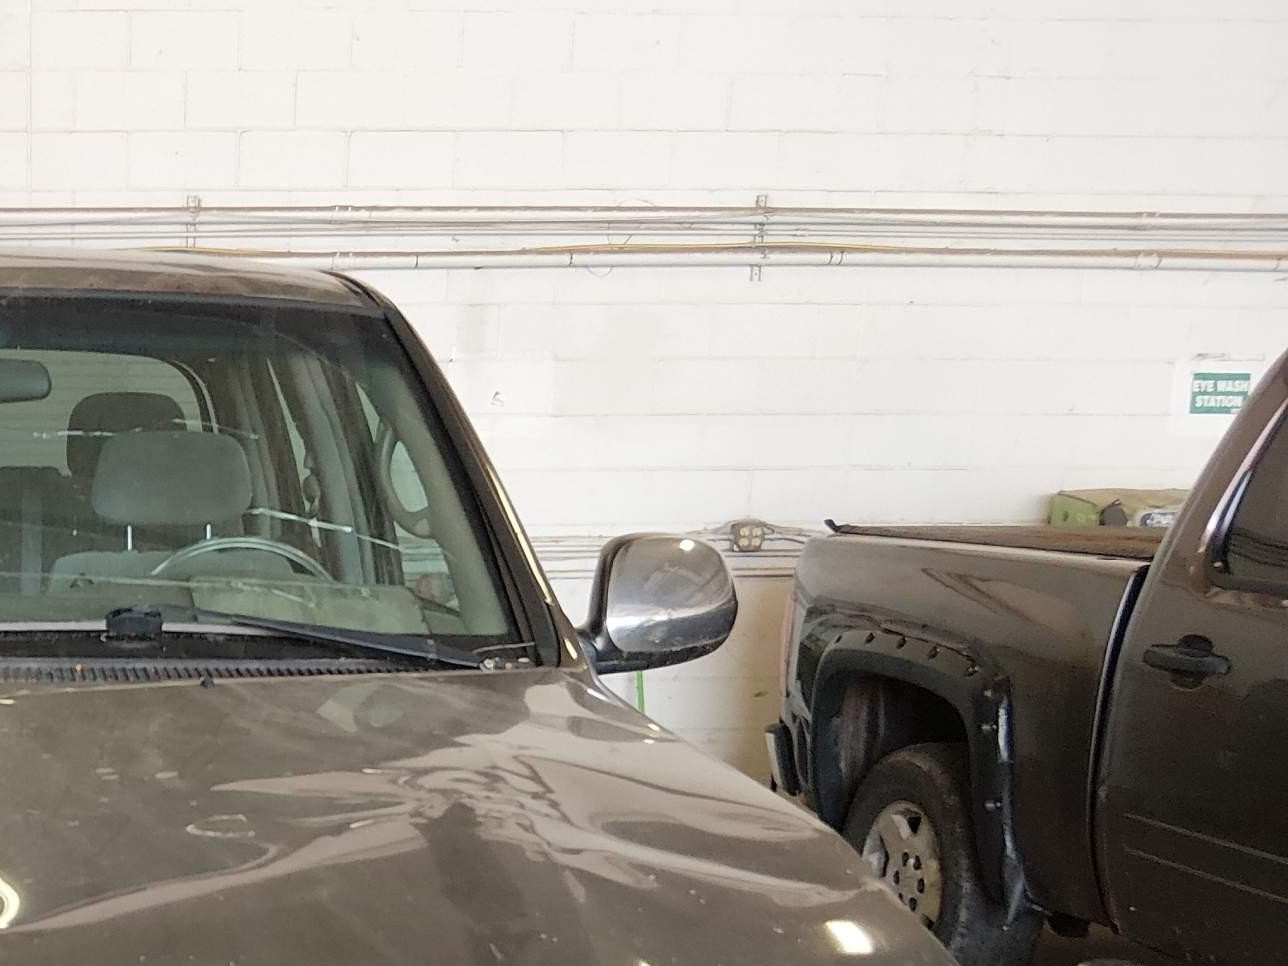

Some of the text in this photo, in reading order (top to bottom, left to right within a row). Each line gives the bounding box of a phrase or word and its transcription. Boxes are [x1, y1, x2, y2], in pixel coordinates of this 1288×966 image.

[1192, 380, 1249, 392] EYE WASH
[1194, 395, 1243, 407] STATION
